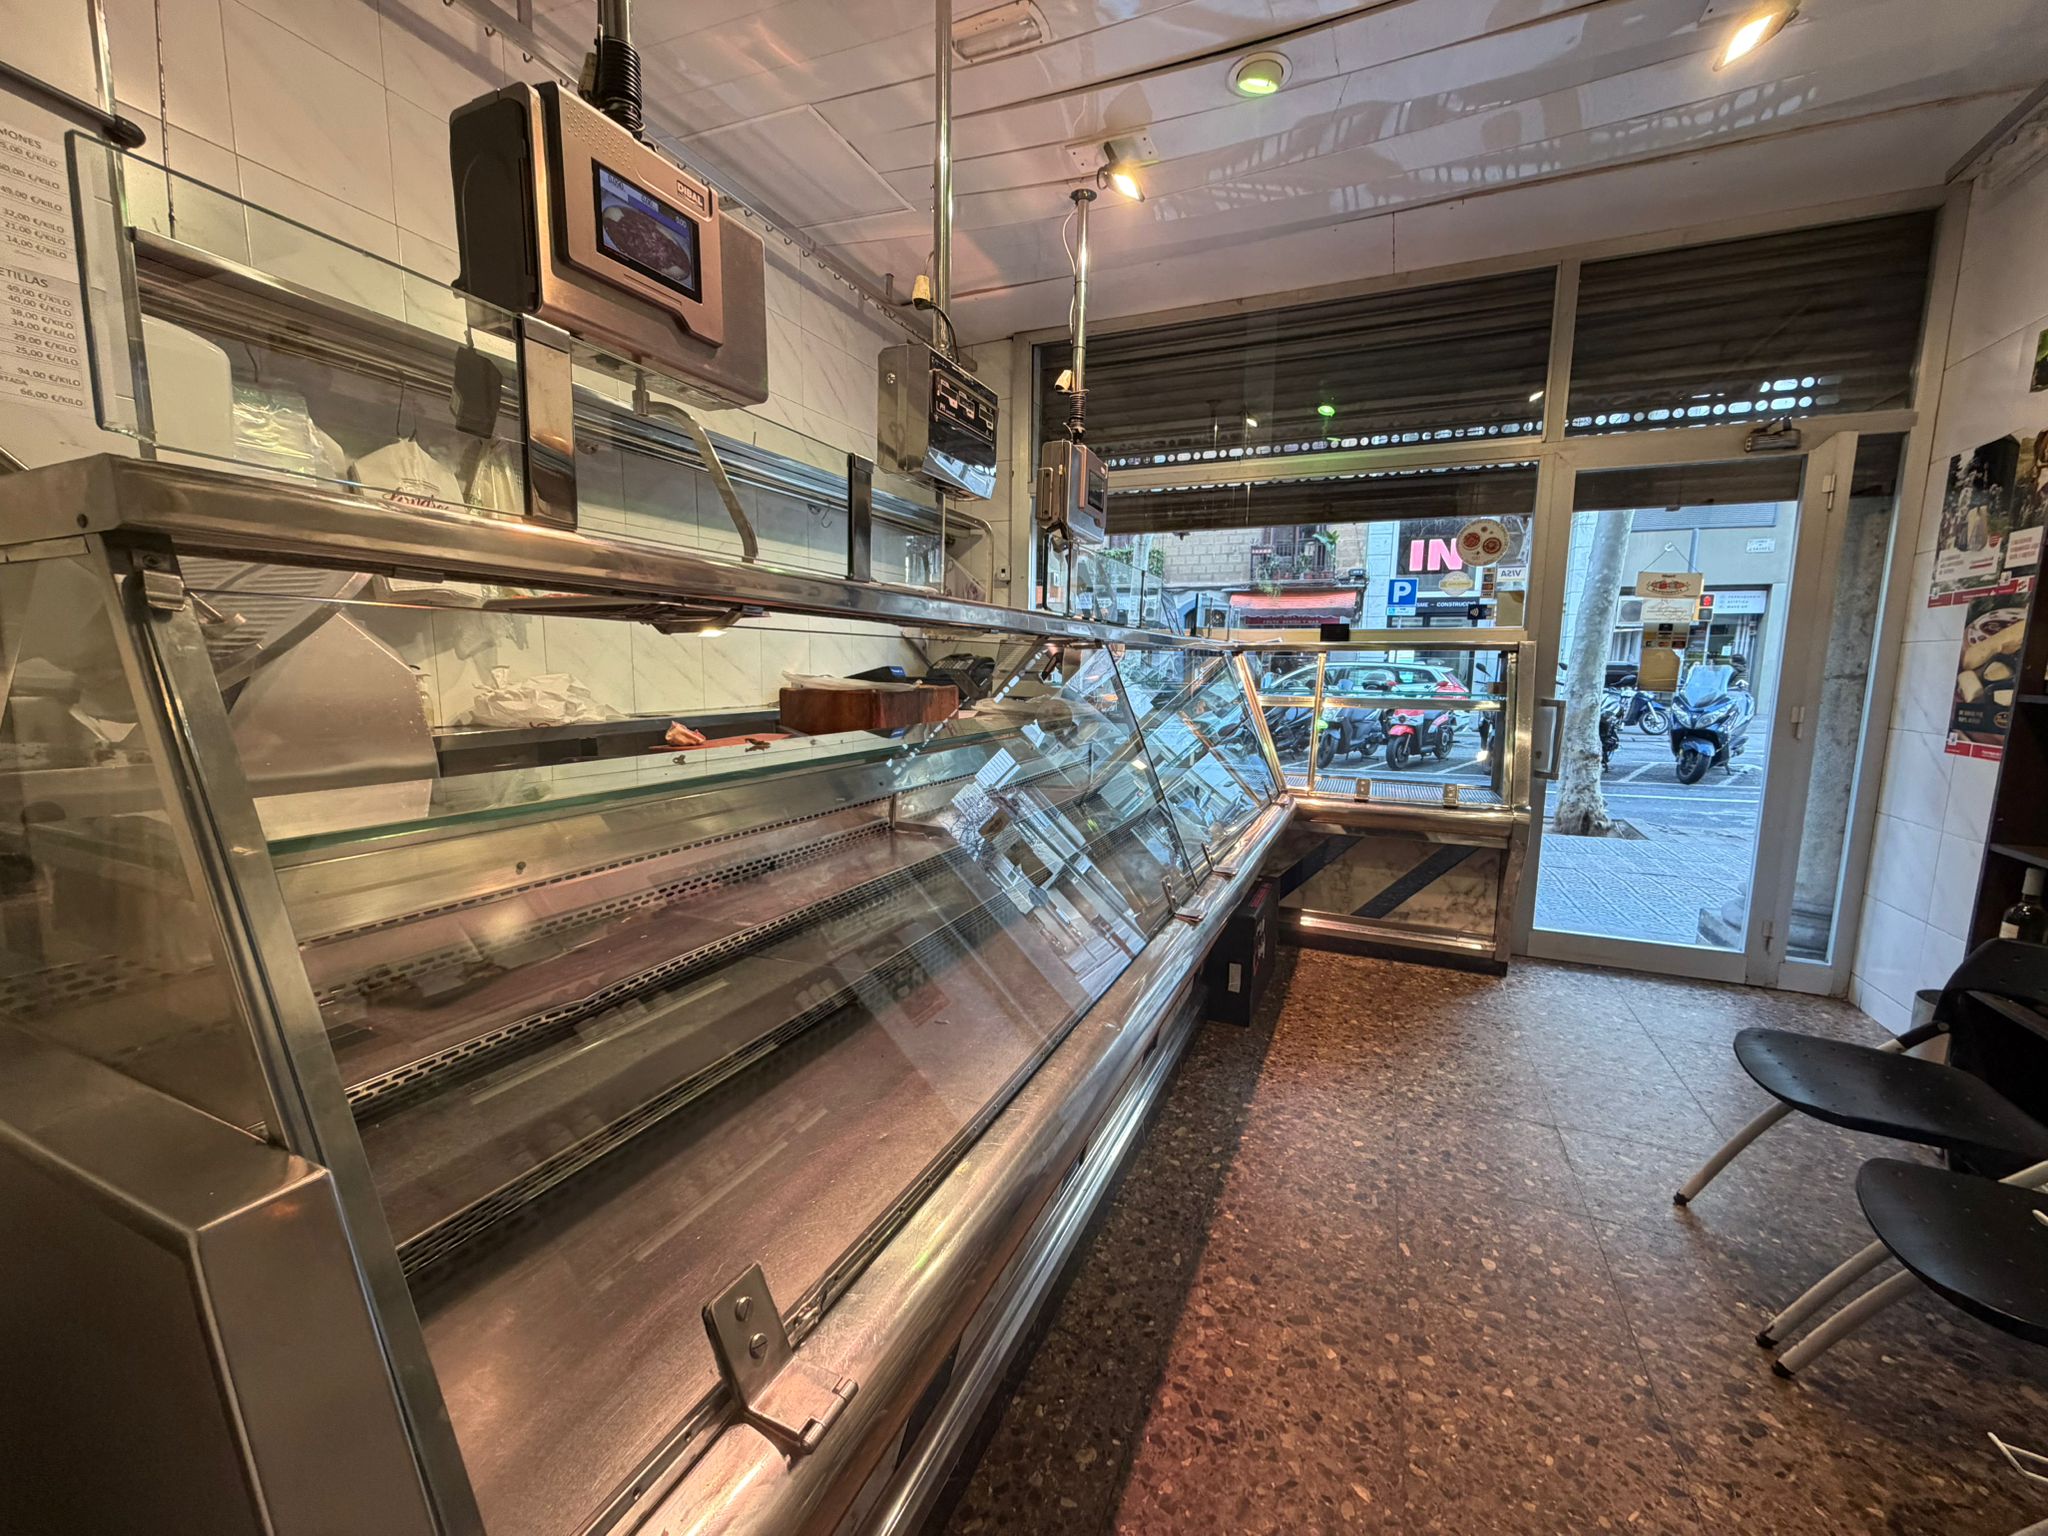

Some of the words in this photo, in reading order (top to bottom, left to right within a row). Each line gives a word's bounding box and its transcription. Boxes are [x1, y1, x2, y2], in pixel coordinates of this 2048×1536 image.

[677, 182, 705, 208] DIBAL
[1409, 538, 1463, 571] IN
[1393, 581, 1412, 603] P
